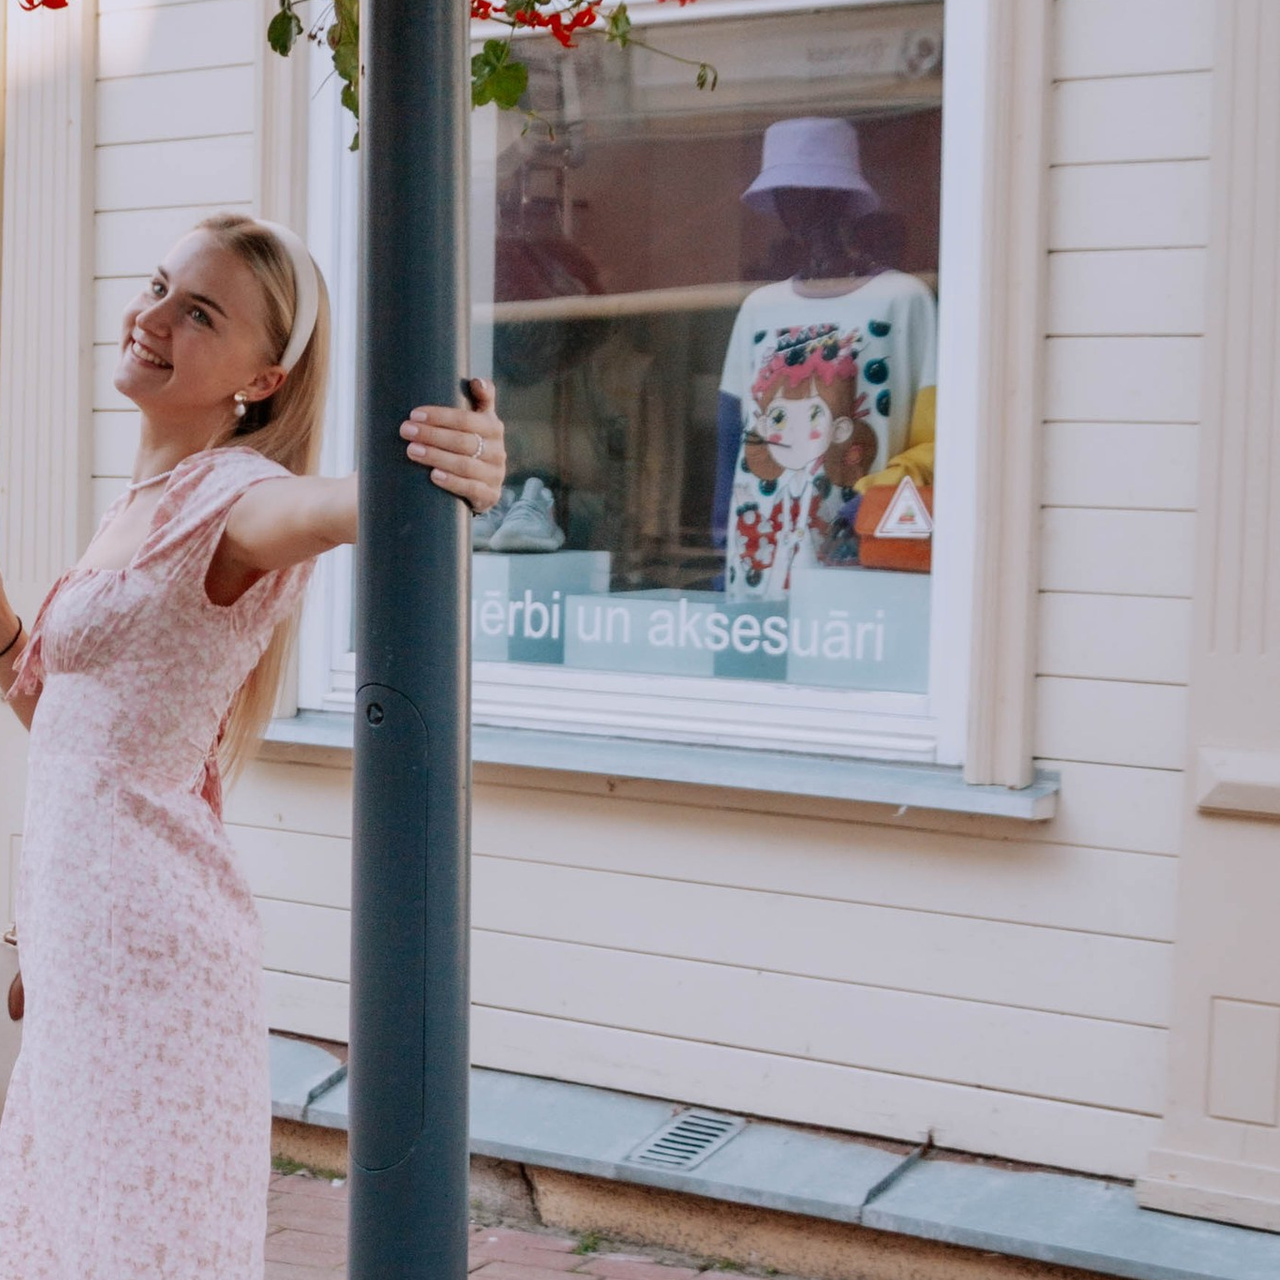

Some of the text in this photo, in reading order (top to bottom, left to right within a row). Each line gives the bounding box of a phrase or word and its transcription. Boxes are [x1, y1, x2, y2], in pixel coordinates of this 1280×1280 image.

[471, 589, 886, 662] ērbi un aksesuāri
